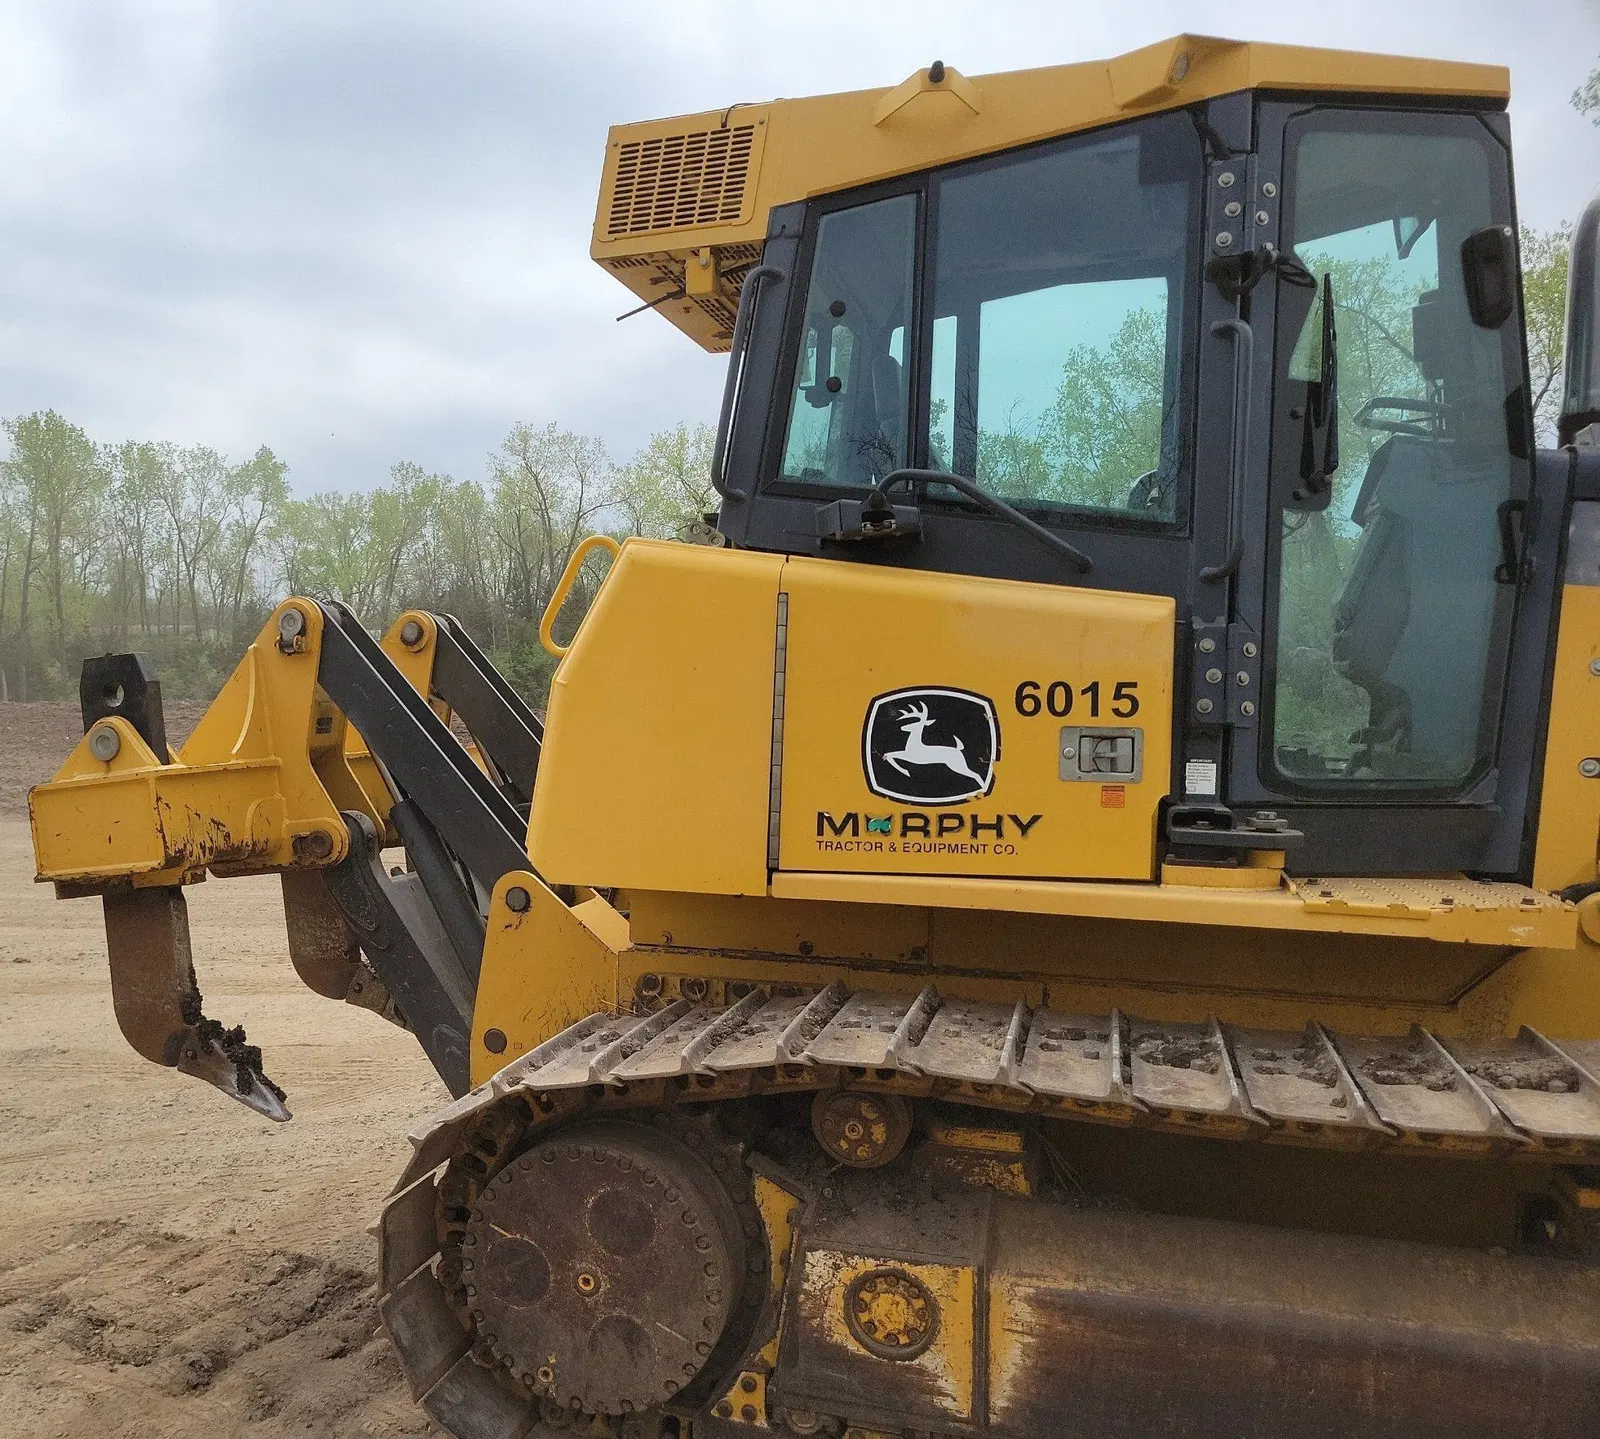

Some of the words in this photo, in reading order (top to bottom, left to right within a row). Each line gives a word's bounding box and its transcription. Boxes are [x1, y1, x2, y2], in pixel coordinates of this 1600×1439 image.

[1015, 680, 1139, 718] 6015
[816, 840, 884, 852] TRACTOR
[888, 841, 897, 853] &
[902, 842, 989, 855] EQUIPMENT
[993, 843, 1019, 856] CO.
